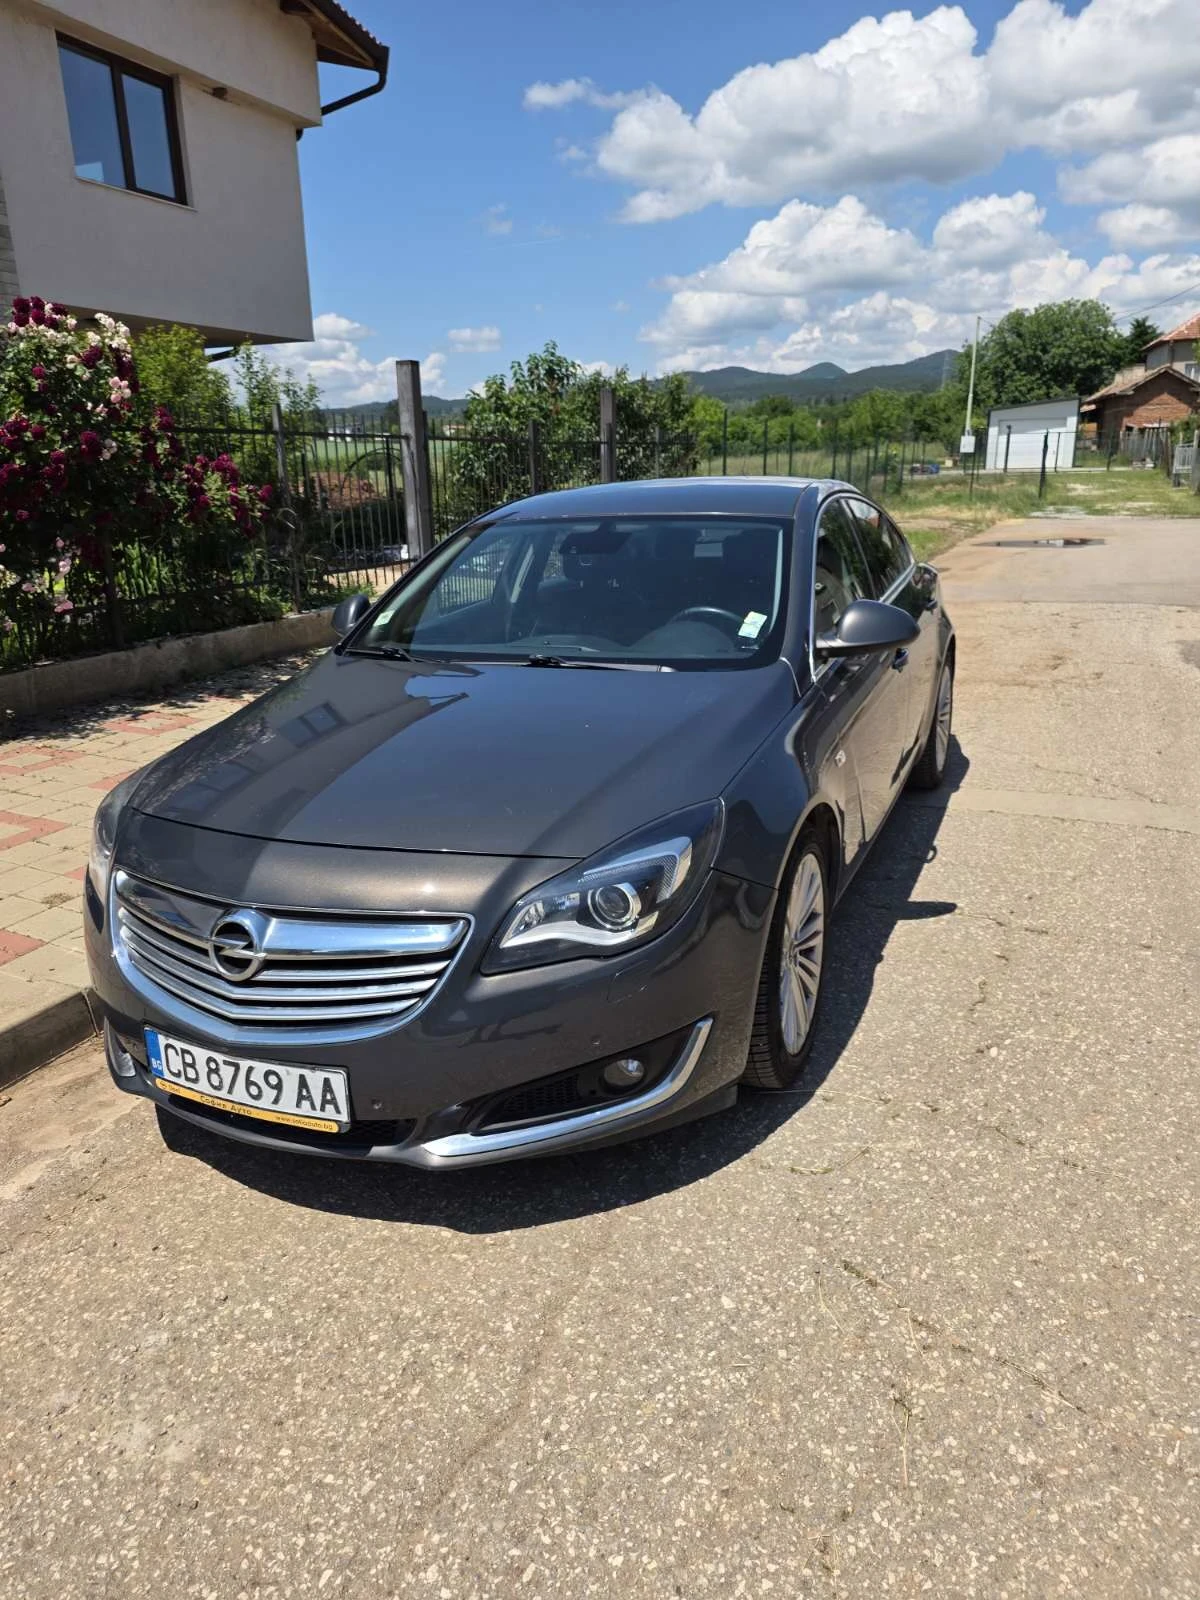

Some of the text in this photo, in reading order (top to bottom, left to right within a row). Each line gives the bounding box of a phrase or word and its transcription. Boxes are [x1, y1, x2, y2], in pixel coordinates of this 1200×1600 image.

[152, 1058, 163, 1070] BG
[164, 1043, 341, 1114] CB 8769 AA
